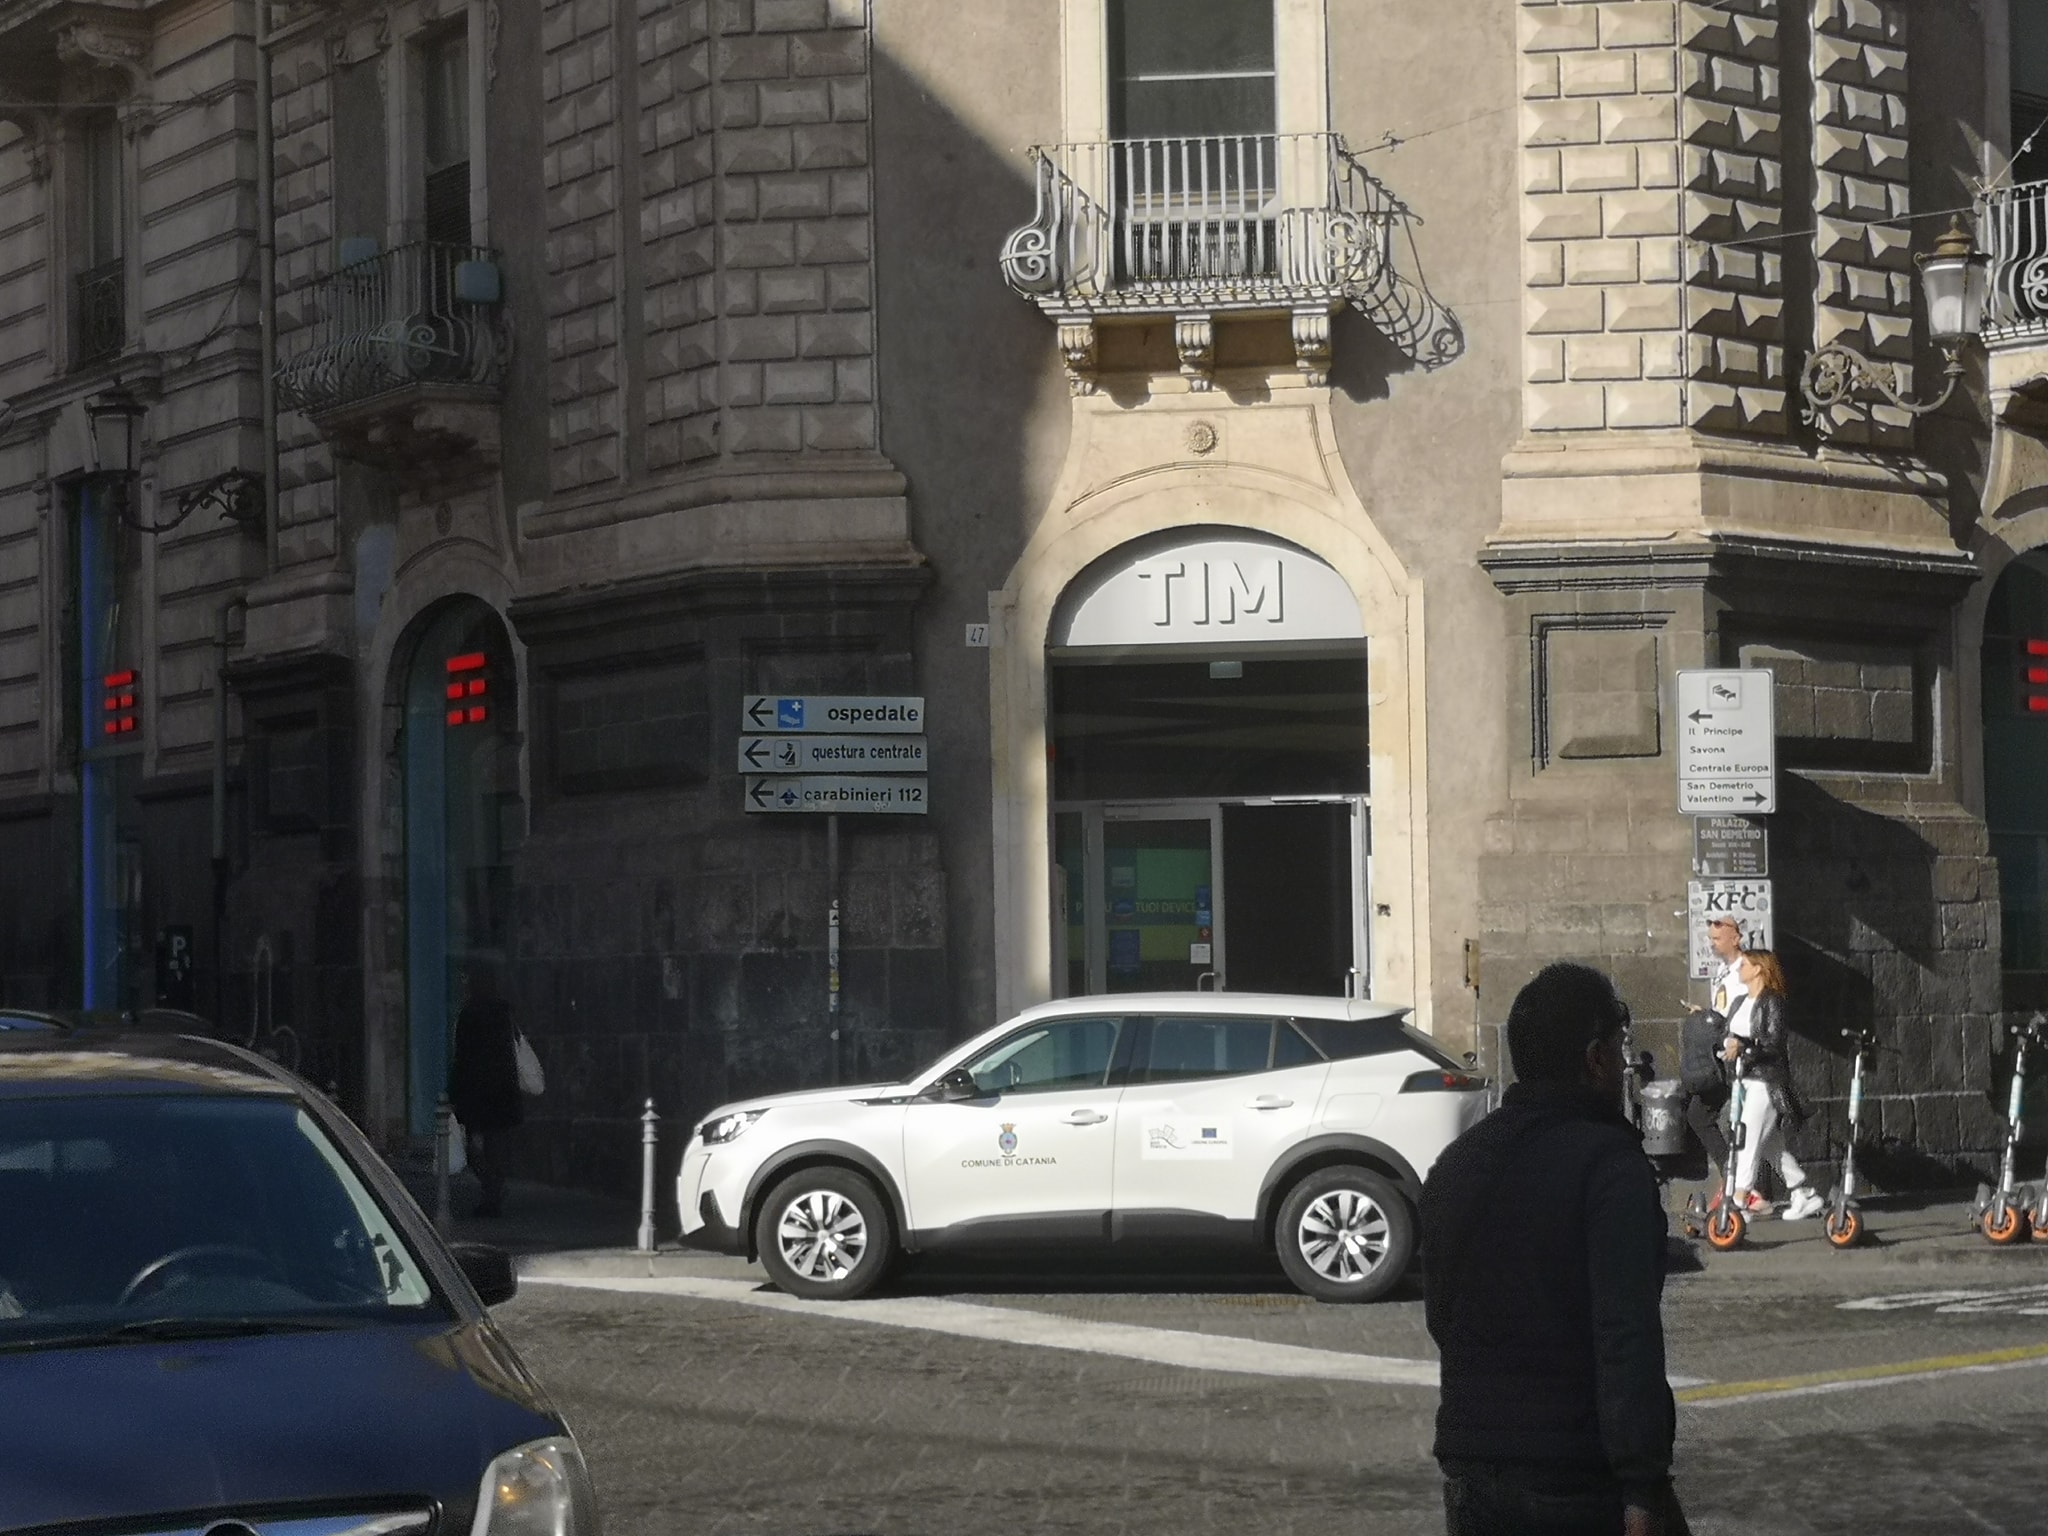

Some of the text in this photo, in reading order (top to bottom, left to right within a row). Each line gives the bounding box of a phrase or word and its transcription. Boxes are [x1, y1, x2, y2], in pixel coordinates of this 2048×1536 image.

[1135, 560, 1285, 626] TIM
[828, 705, 919, 724] ospedale
[1703, 727, 1743, 737] Principe
[812, 744, 922, 762] questura centrale
[1690, 746, 1725, 754] Savona
[1689, 764, 1769, 773] Centrale Europa
[1687, 782, 1754, 790] San Demetrio
[804, 787, 922, 801] carabinieri 112
[1687, 795, 1734, 803] Valentino
[1711, 818, 1750, 828] PALAZZO
[1700, 829, 1761, 839] SAN DEMETRIO
[1704, 891, 1757, 911] KFC
[961, 1159, 1001, 1168] COMUNE
[1015, 1157, 1057, 1166] CATANIA
